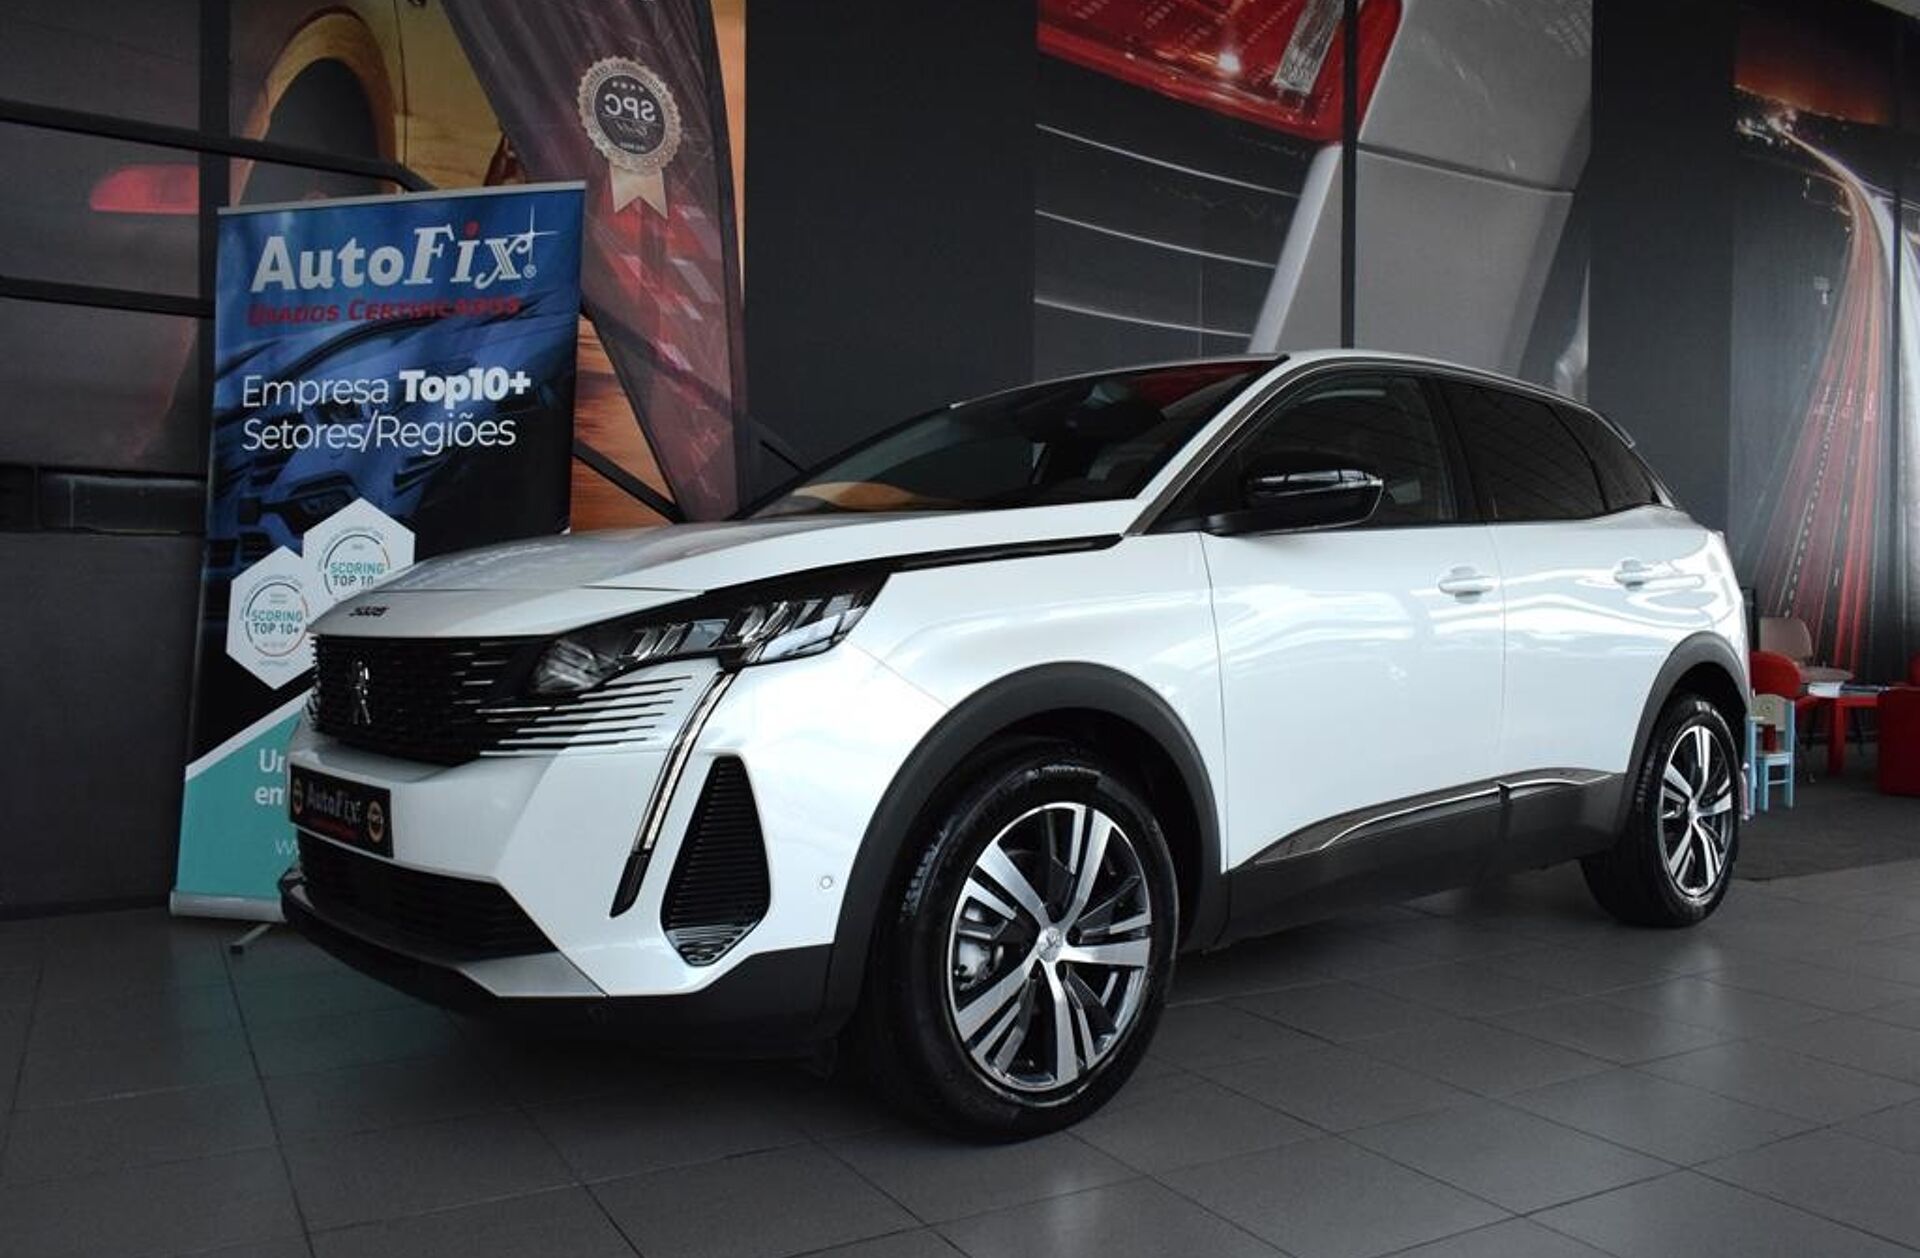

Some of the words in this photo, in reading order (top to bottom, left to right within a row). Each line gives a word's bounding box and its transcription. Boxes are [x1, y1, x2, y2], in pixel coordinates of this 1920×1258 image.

[242, 374, 389, 411] Empresa
[399, 366, 532, 408] Top10+
[241, 410, 517, 455] Setores/Regiões
[329, 561, 385, 575] SCORING
[332, 575, 356, 586] TOP
[250, 609, 303, 622] SCORING
[253, 622, 277, 634] TOP
